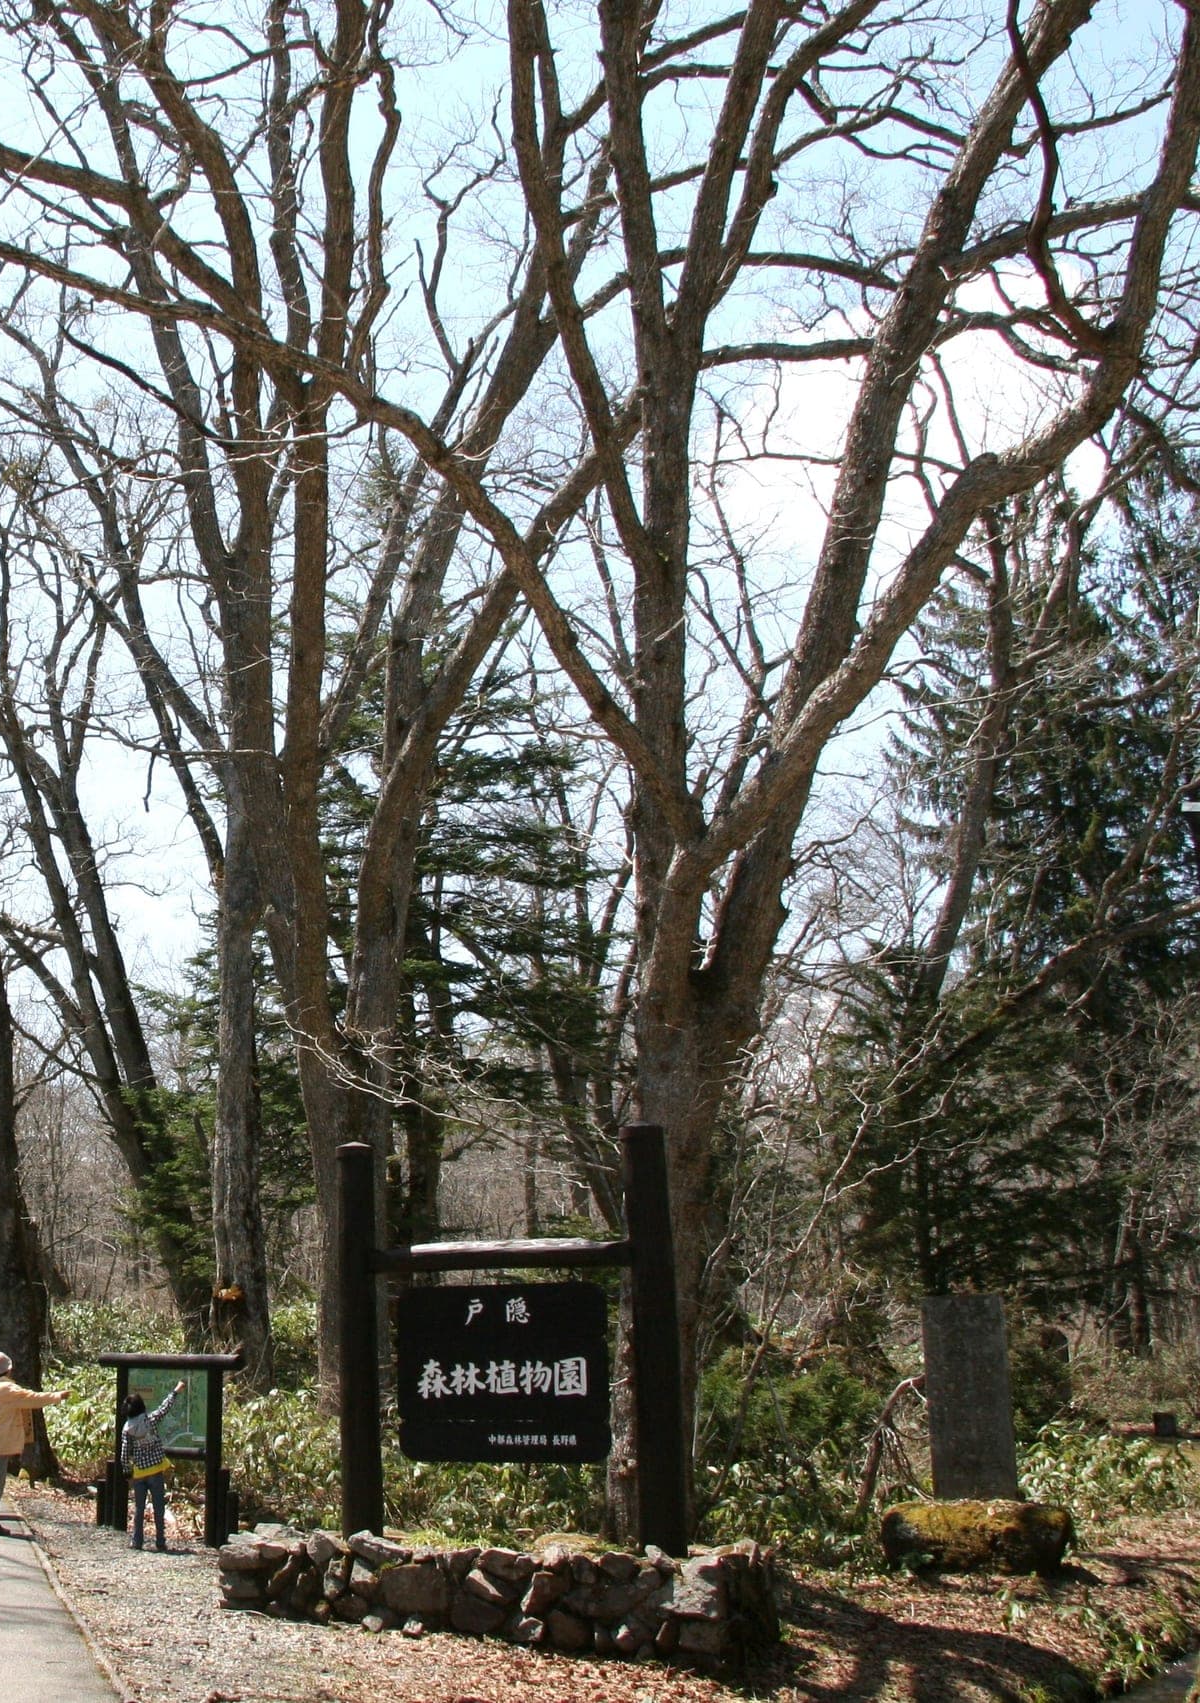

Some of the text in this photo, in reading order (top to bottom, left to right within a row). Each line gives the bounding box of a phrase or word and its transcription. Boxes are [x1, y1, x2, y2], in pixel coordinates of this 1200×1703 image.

[464, 1296, 531, 1326] 戸隠
[417, 1356, 588, 1400] 森林植物園
